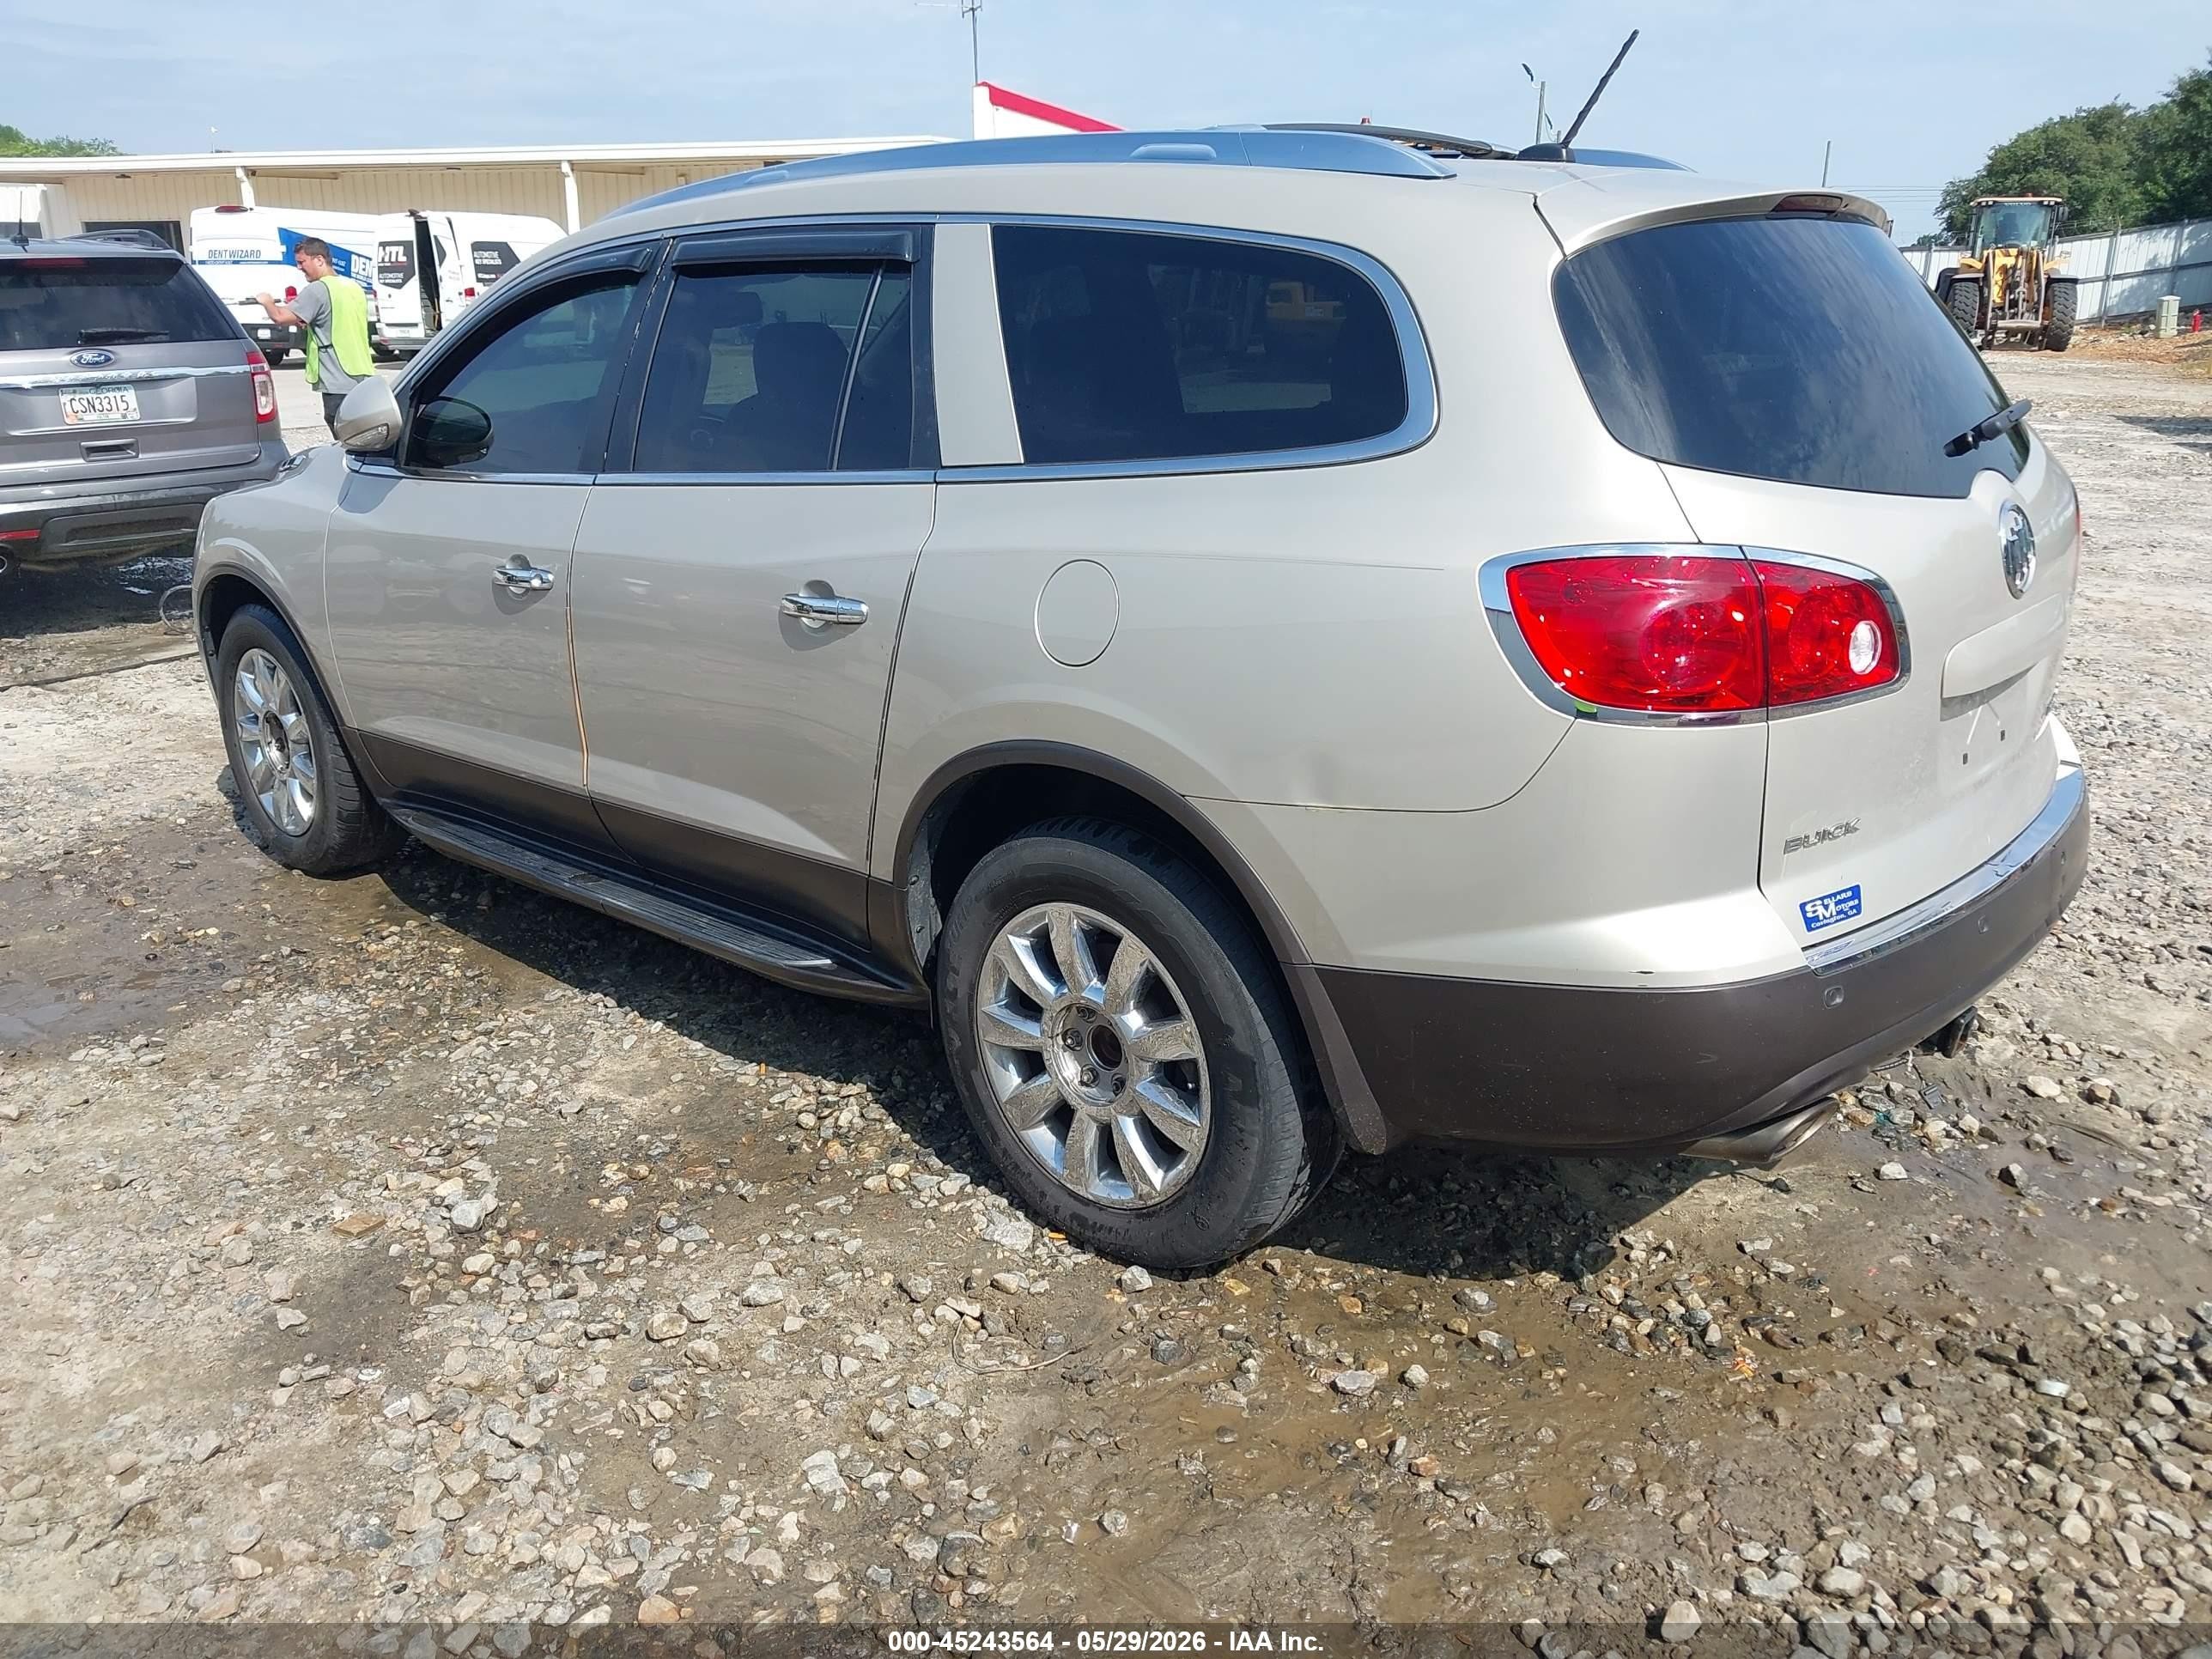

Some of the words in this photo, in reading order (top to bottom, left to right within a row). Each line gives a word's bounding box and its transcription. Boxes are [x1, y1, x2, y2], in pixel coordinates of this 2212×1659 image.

[80, 352, 106, 364] Ford
[70, 395, 130, 414] CSN3315
[1783, 817, 1862, 855] BUICK
[1847, 908, 1857, 916] GA
